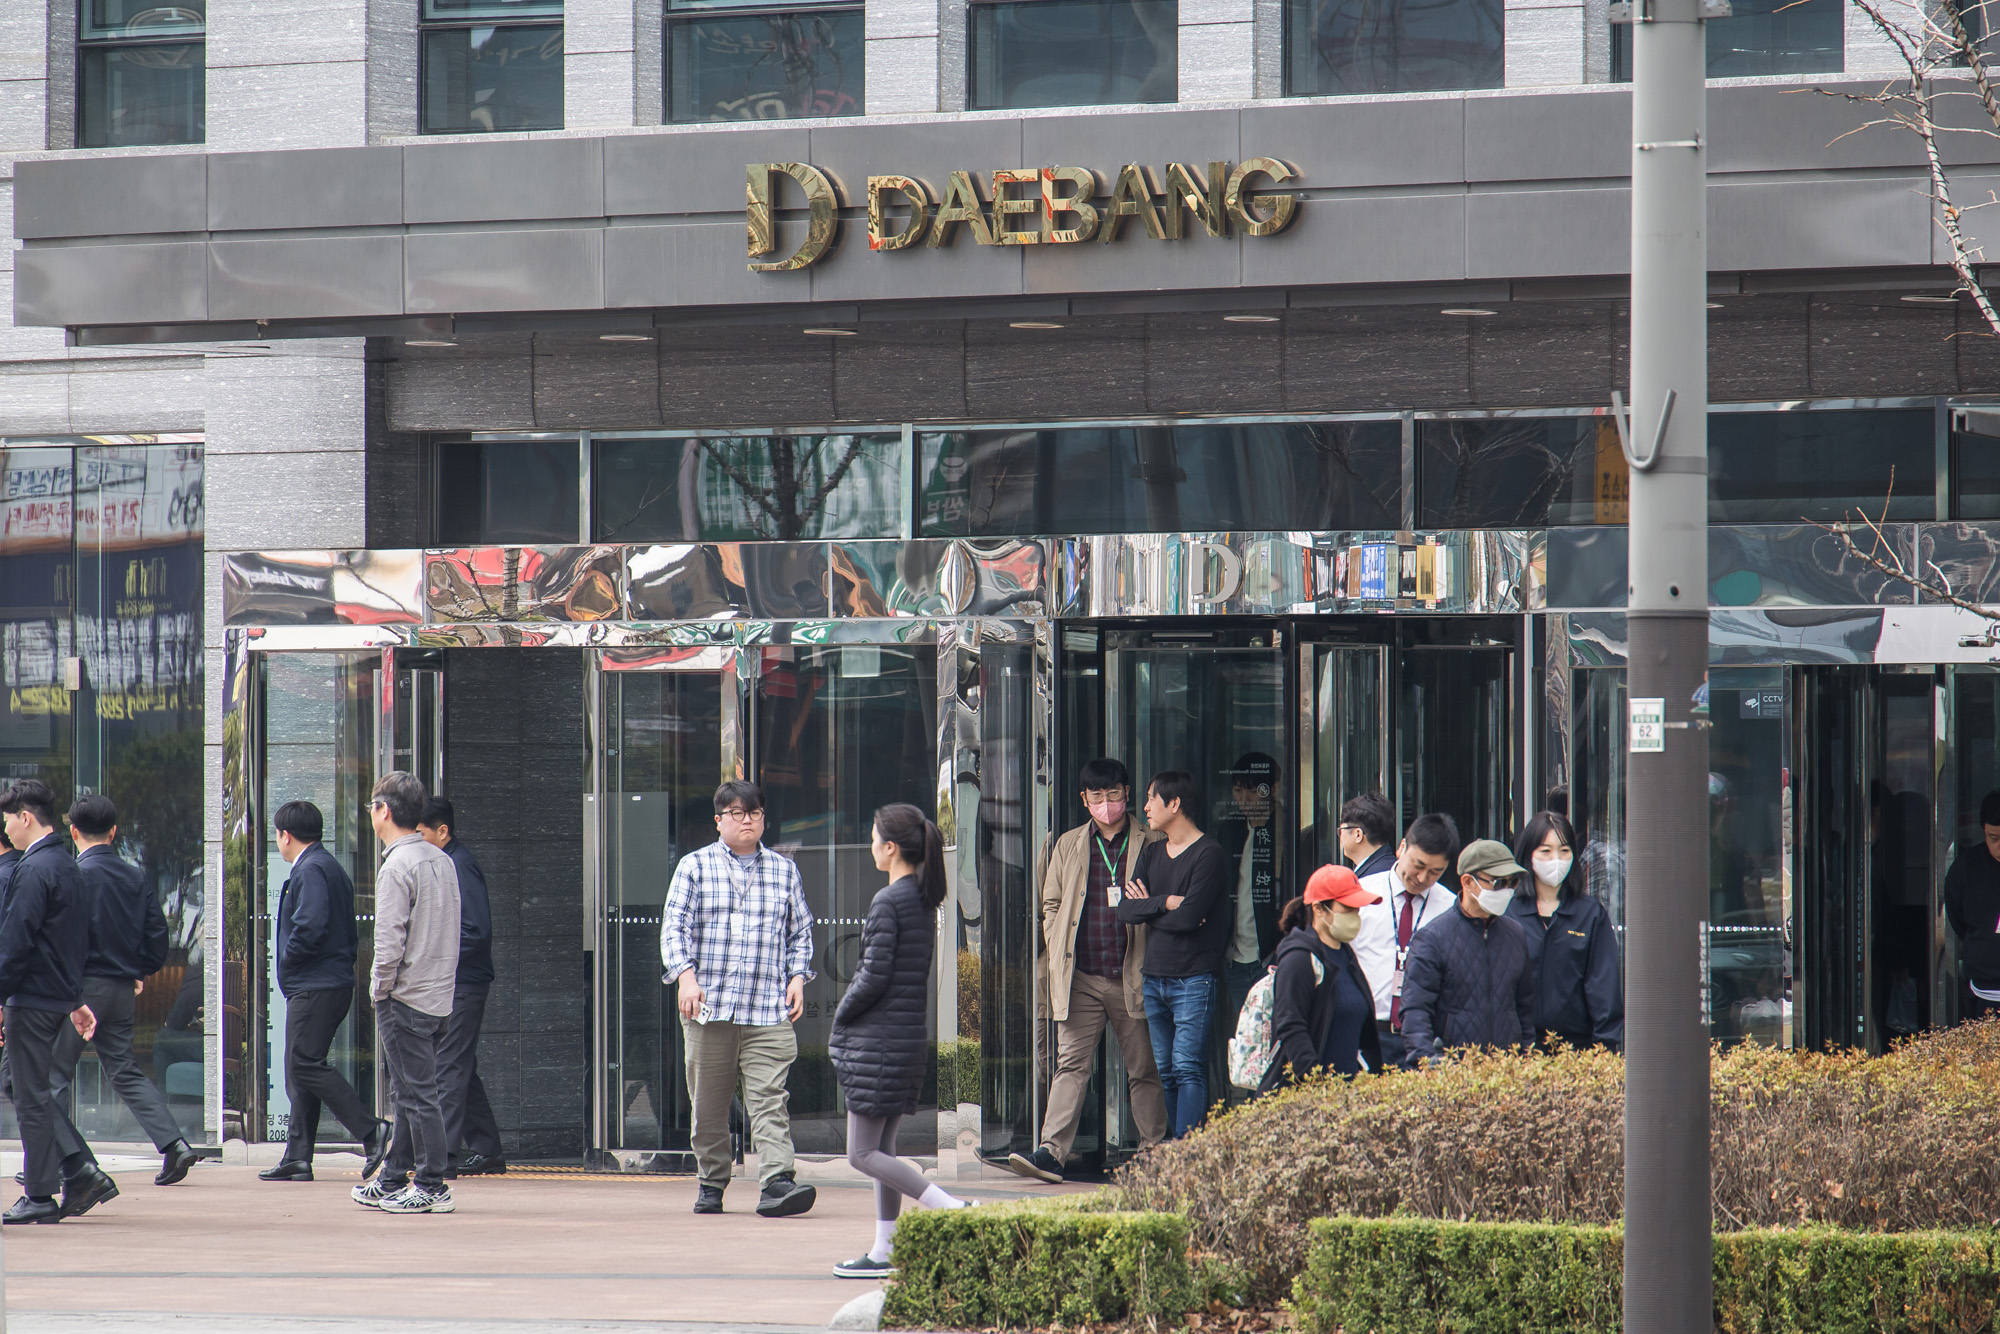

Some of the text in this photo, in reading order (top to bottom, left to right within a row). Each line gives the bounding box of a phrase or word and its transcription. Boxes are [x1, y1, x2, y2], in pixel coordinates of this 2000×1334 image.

[746, 157, 1300, 273] D DAEBANG
[1762, 695, 1784, 703] CCTV
[1639, 725, 1652, 737] 62
